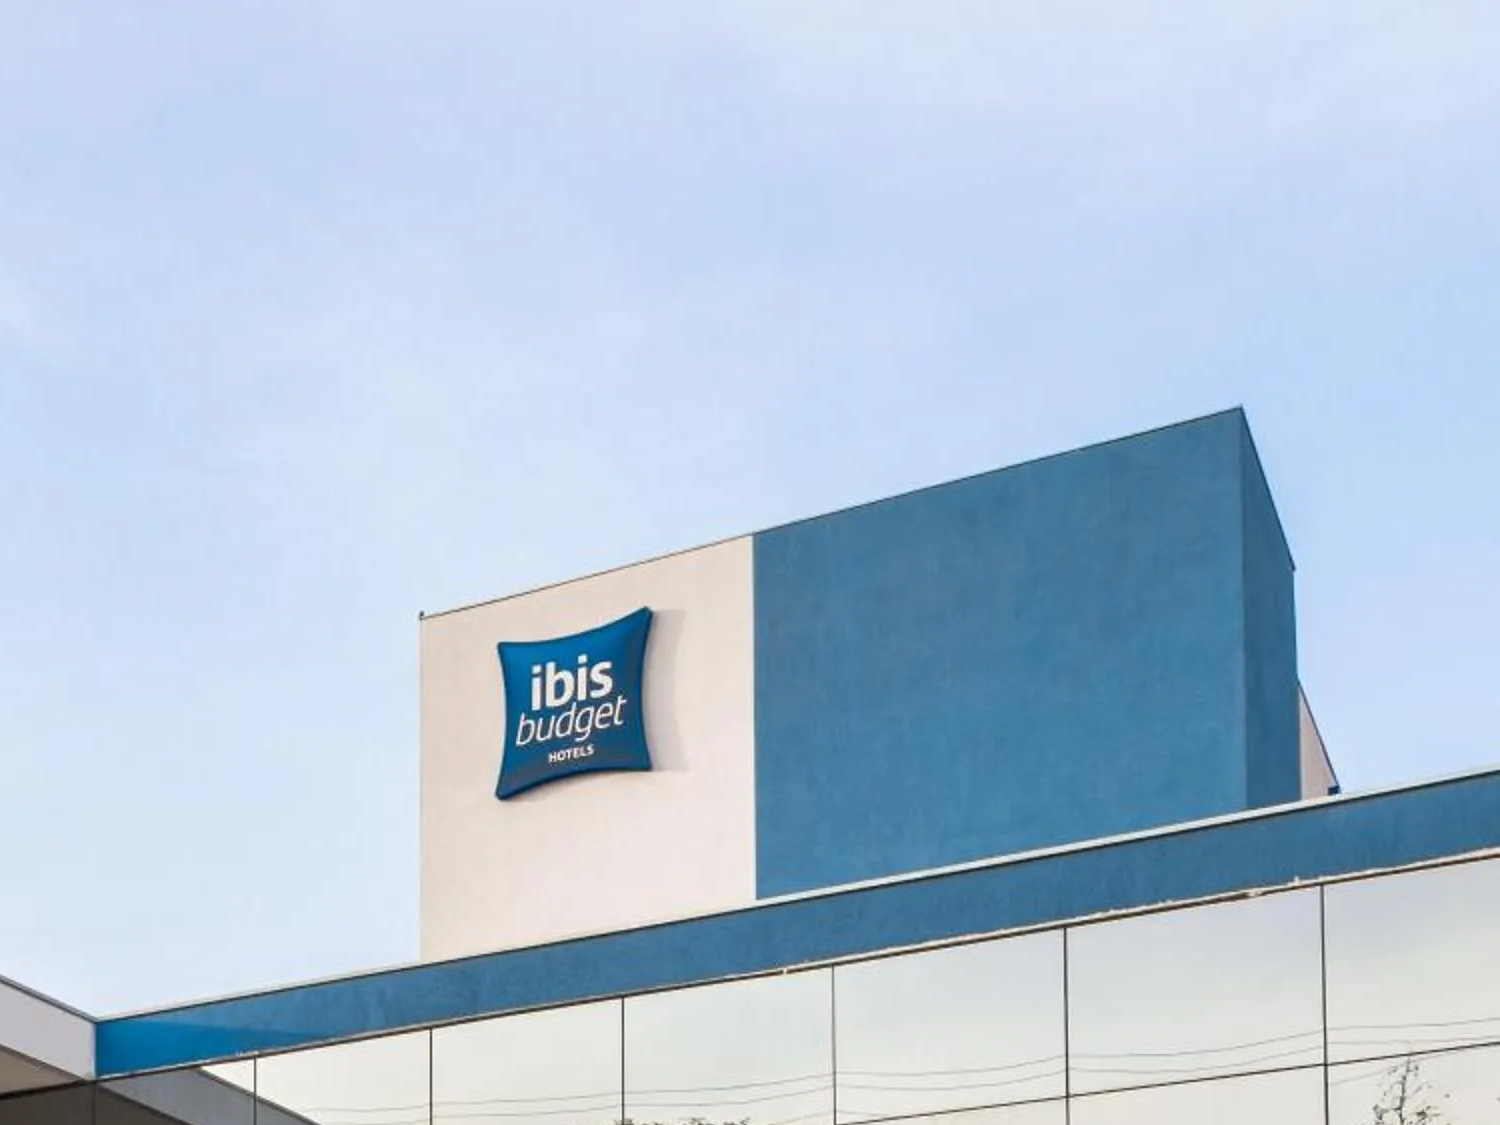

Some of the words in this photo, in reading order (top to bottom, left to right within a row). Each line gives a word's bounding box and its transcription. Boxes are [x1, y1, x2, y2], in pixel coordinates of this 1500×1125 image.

[531, 653, 614, 711] ibis
[515, 695, 628, 747] budget
[548, 744, 595, 763] HOTELS
